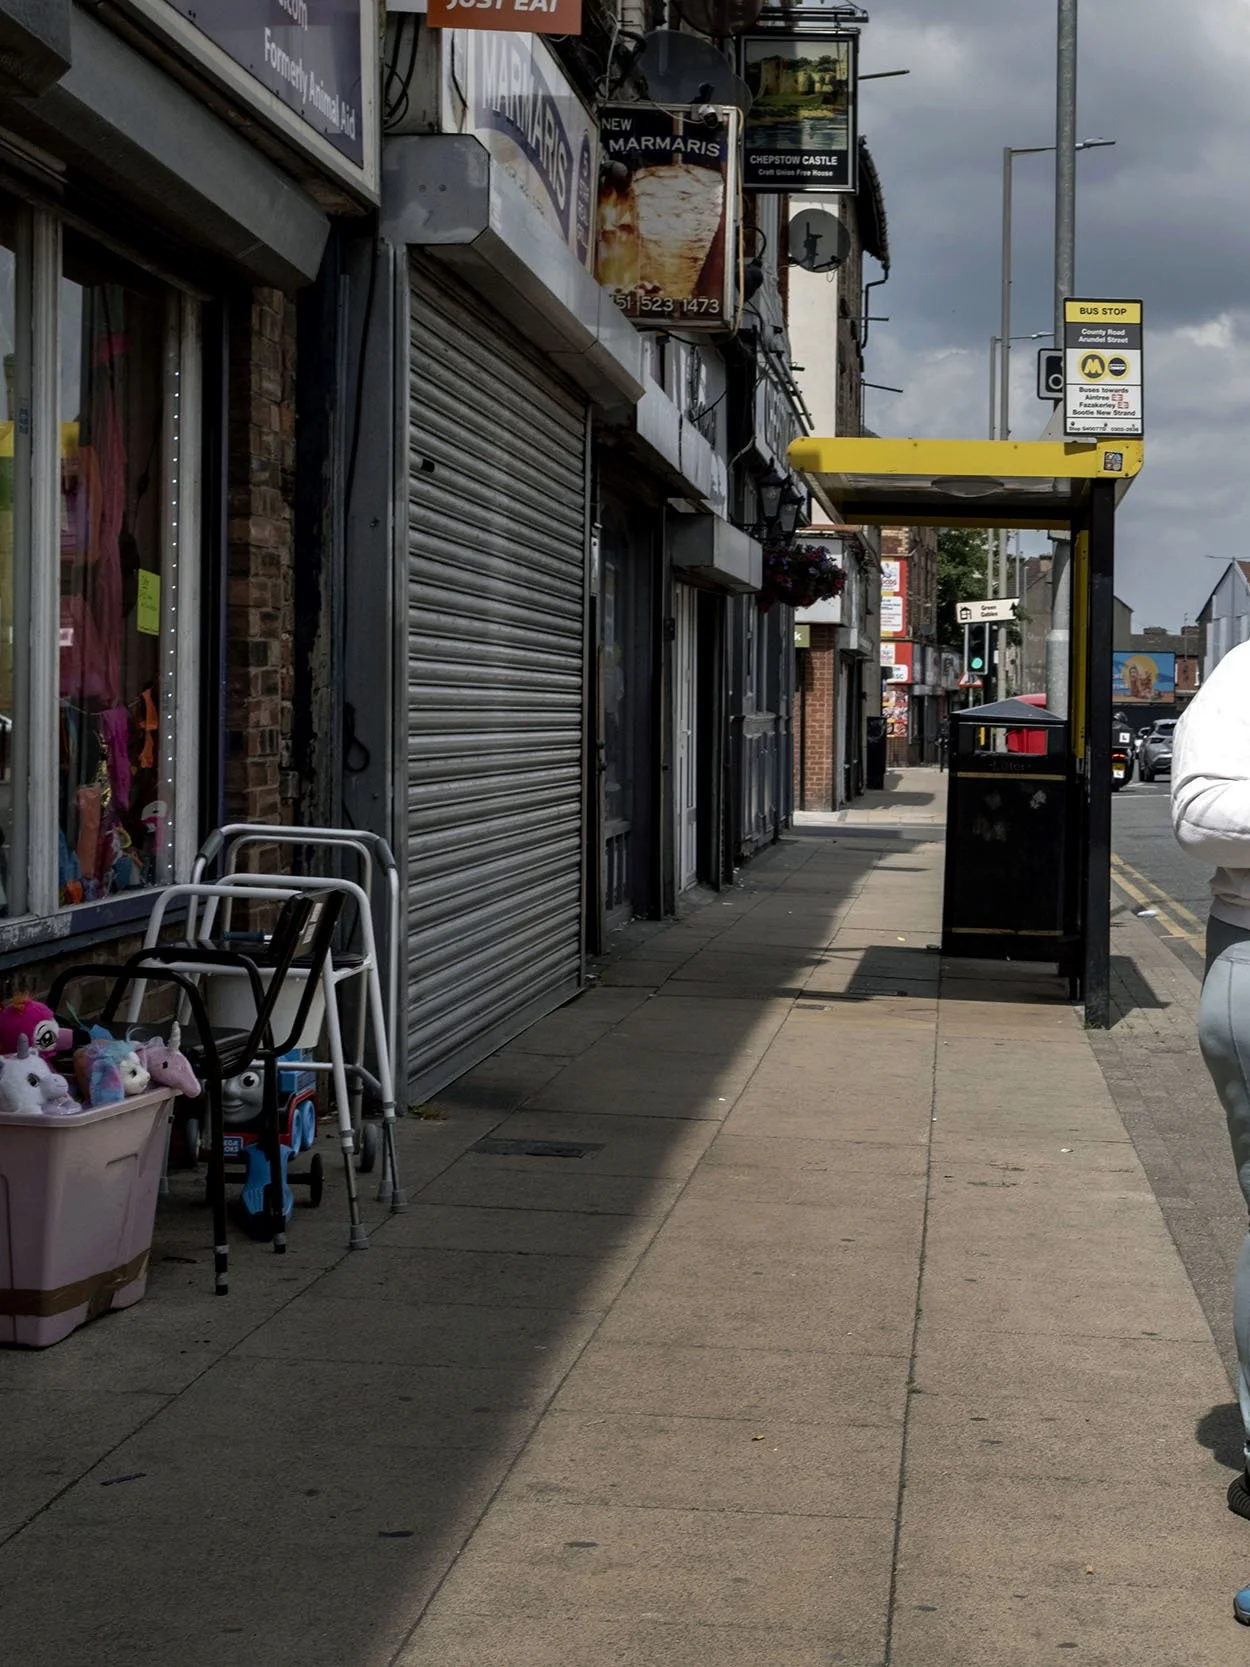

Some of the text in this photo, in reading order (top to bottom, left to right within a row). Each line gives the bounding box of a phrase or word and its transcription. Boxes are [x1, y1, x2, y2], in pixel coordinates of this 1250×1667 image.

[264, 26, 356, 141] Formerly Animal Aid
[482, 31, 568, 211] MARMARIS
[601, 118, 632, 131] NEW
[609, 136, 721, 157] MARMARIS
[750, 155, 838, 165] CHEPSTOW CASTLE
[641, 296, 674, 312] 523
[682, 299, 720, 313] 1473
[1080, 307, 1127, 316] BUS STOP
[1081, 328, 1106, 337] County
